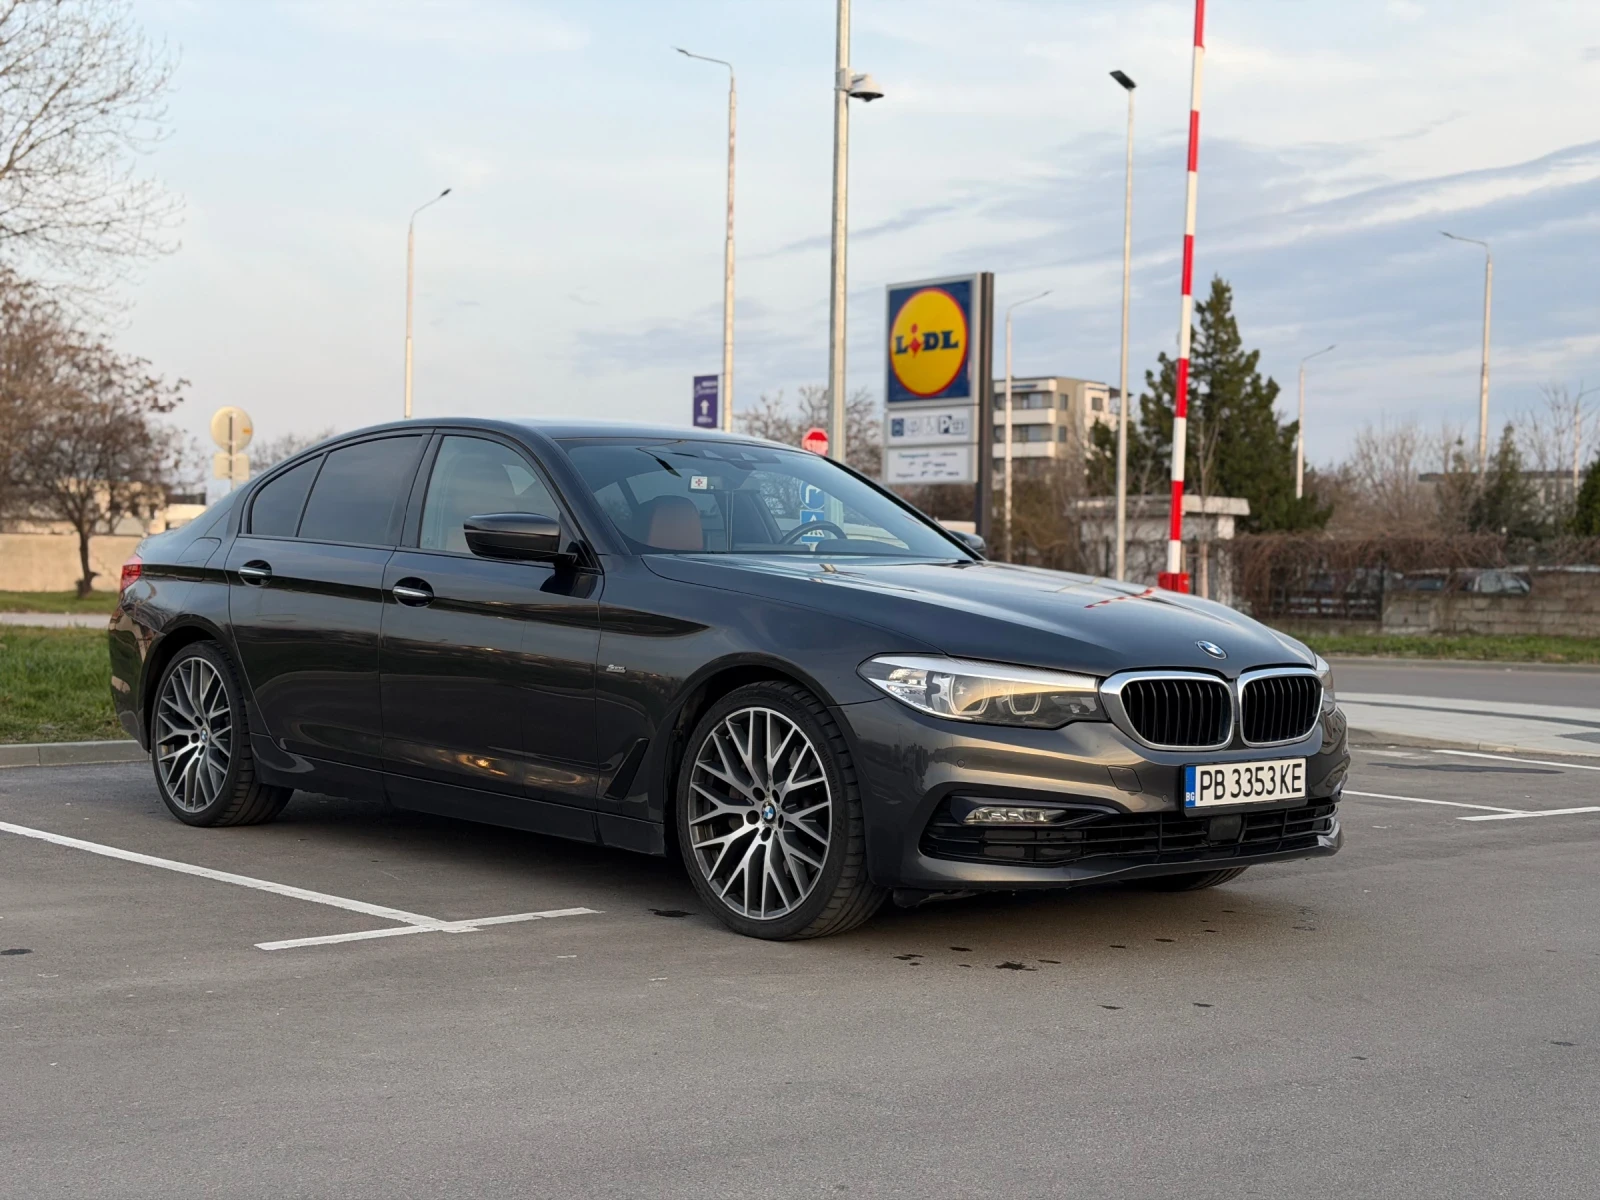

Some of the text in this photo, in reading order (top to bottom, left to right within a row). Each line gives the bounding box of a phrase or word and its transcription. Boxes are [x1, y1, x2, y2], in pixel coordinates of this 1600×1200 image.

[1200, 763, 1302, 801] PB 3353 KE
[1186, 791, 1195, 802] BG
